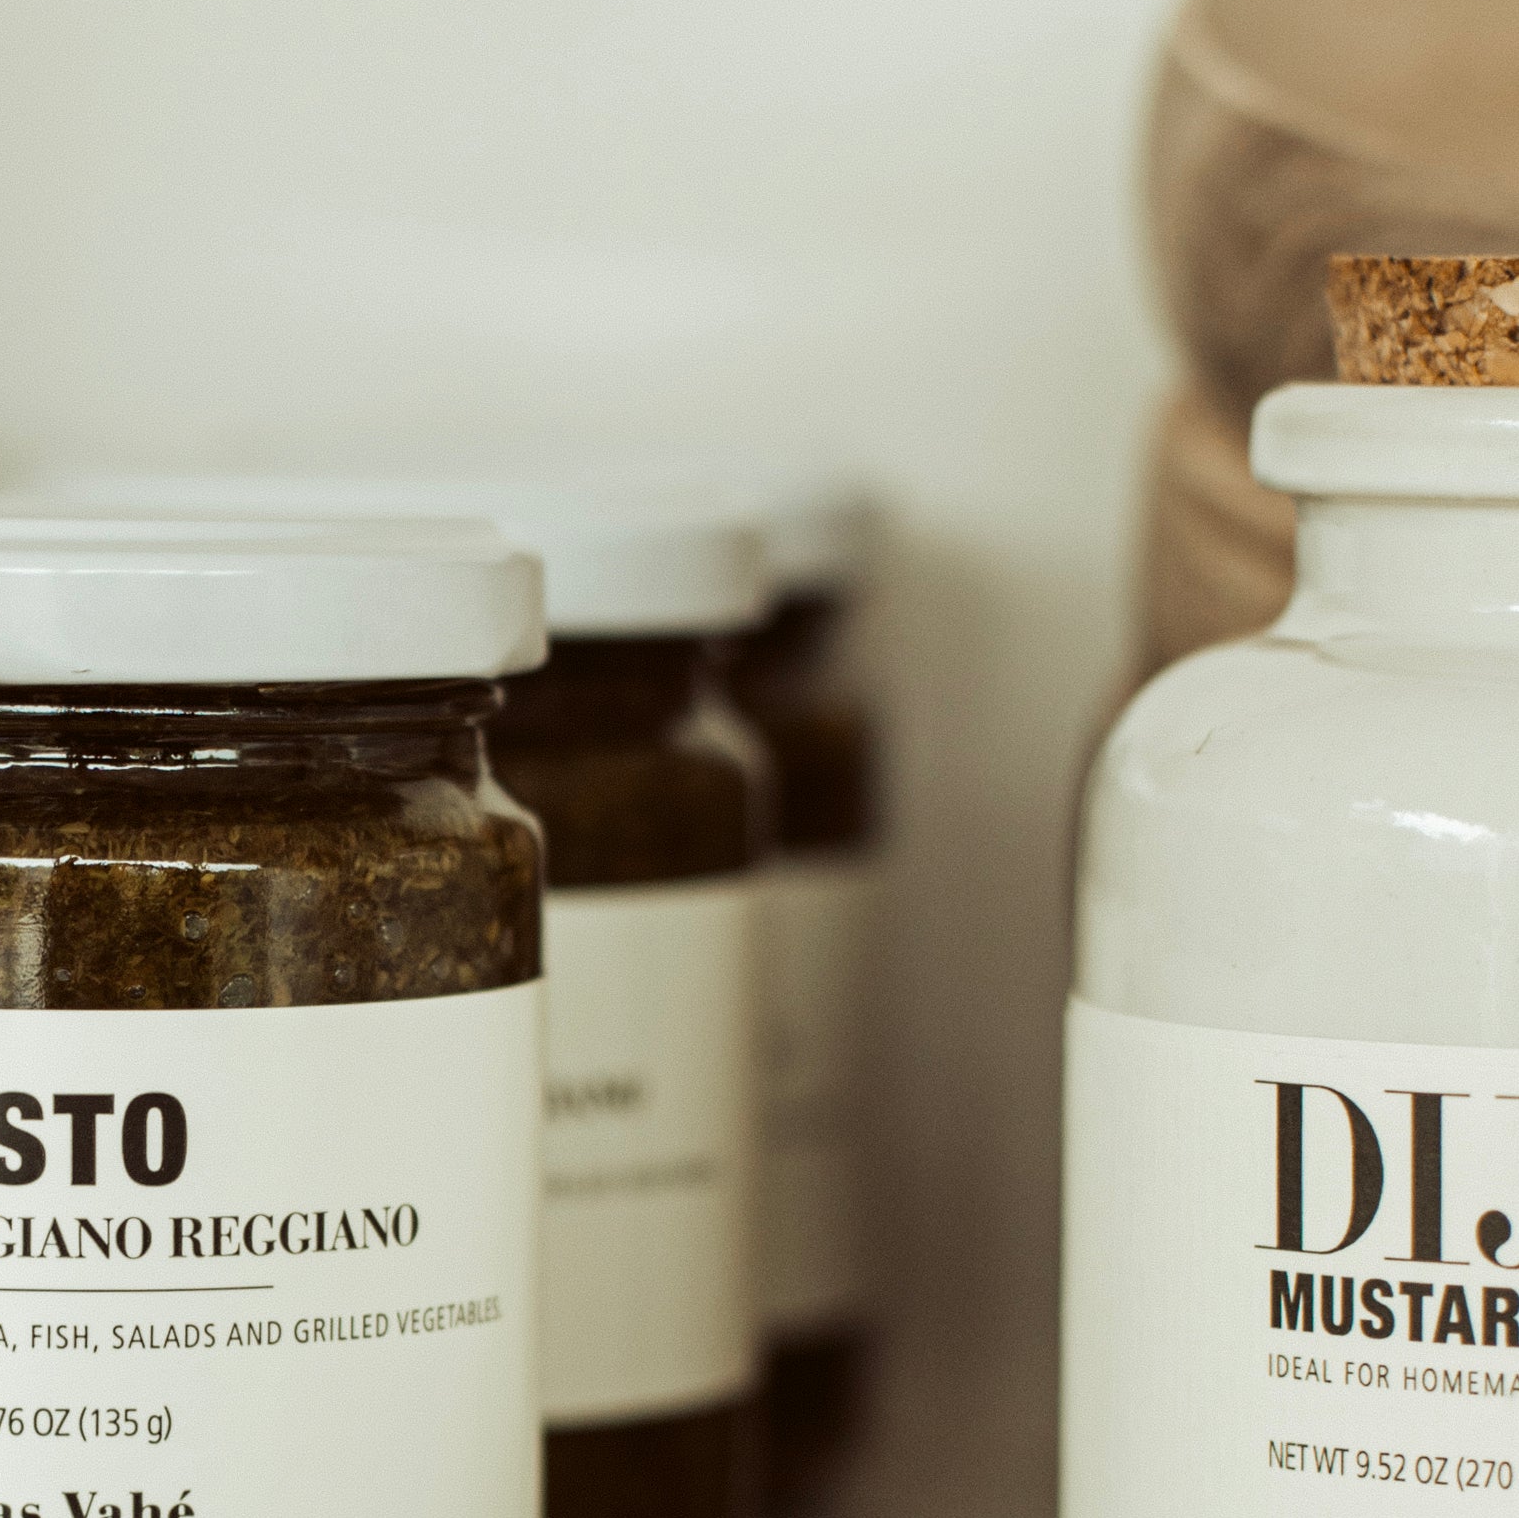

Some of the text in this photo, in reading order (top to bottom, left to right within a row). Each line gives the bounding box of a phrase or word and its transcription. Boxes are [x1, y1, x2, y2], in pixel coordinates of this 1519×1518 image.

[169, 1204, 420, 1259] REGGIANO
[1269, 1269, 1519, 1348] MUSTAR
[29, 1323, 99, 1354] FISH,
[110, 1322, 216, 1350] SALADS
[224, 1320, 283, 1347] AND
[292, 1312, 390, 1345] GRILLED
[1267, 1353, 1333, 1385] IDEAL
[1343, 1360, 1390, 1389] FOR
[31, 1407, 71, 1438] OZ
[77, 1406, 139, 1443] (135
[145, 1405, 173, 1445] g)
[1267, 1439, 1514, 1492] NET WT 9.52 OZ (270
